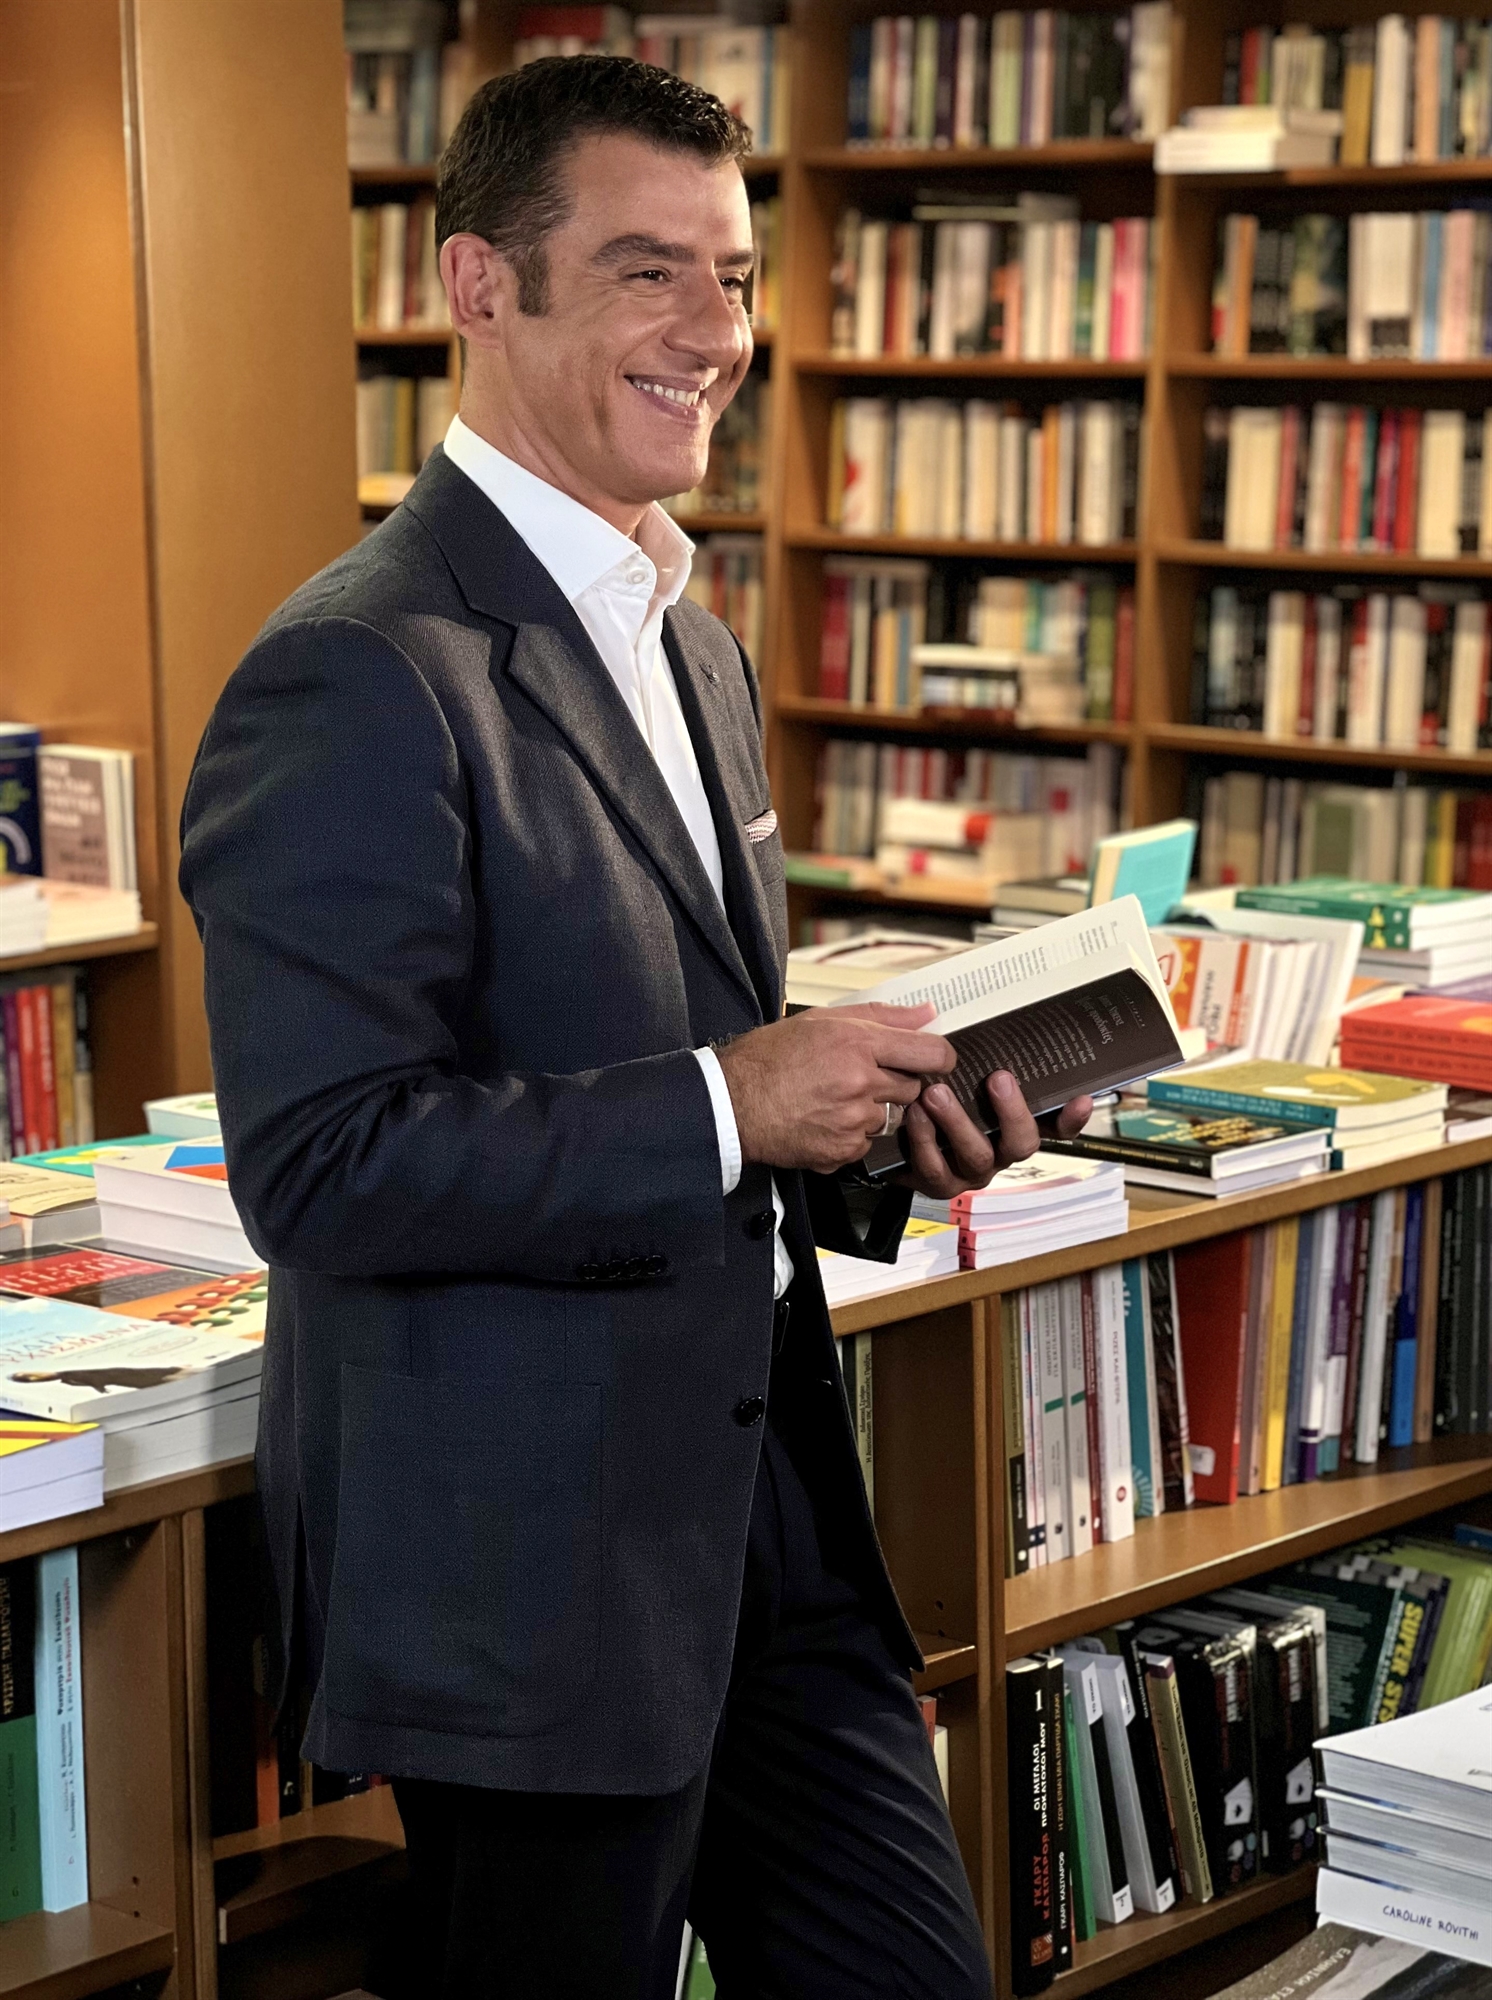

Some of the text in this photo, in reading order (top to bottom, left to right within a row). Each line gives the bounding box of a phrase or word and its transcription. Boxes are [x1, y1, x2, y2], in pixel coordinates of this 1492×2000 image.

[1390, 1603, 1424, 1677] SUPER
[1053, 1693, 1061, 1720] ΣΚΑΚΙ
[1033, 1798, 1040, 1810] ΟΙ
[1033, 1855, 1041, 1906] ΓΚΑΡΥ
[1383, 1905, 1479, 1940] CAROLINE ROVITHI
[1294, 1947, 1352, 1986] ΕΛΛΗΝΙΚΗ
